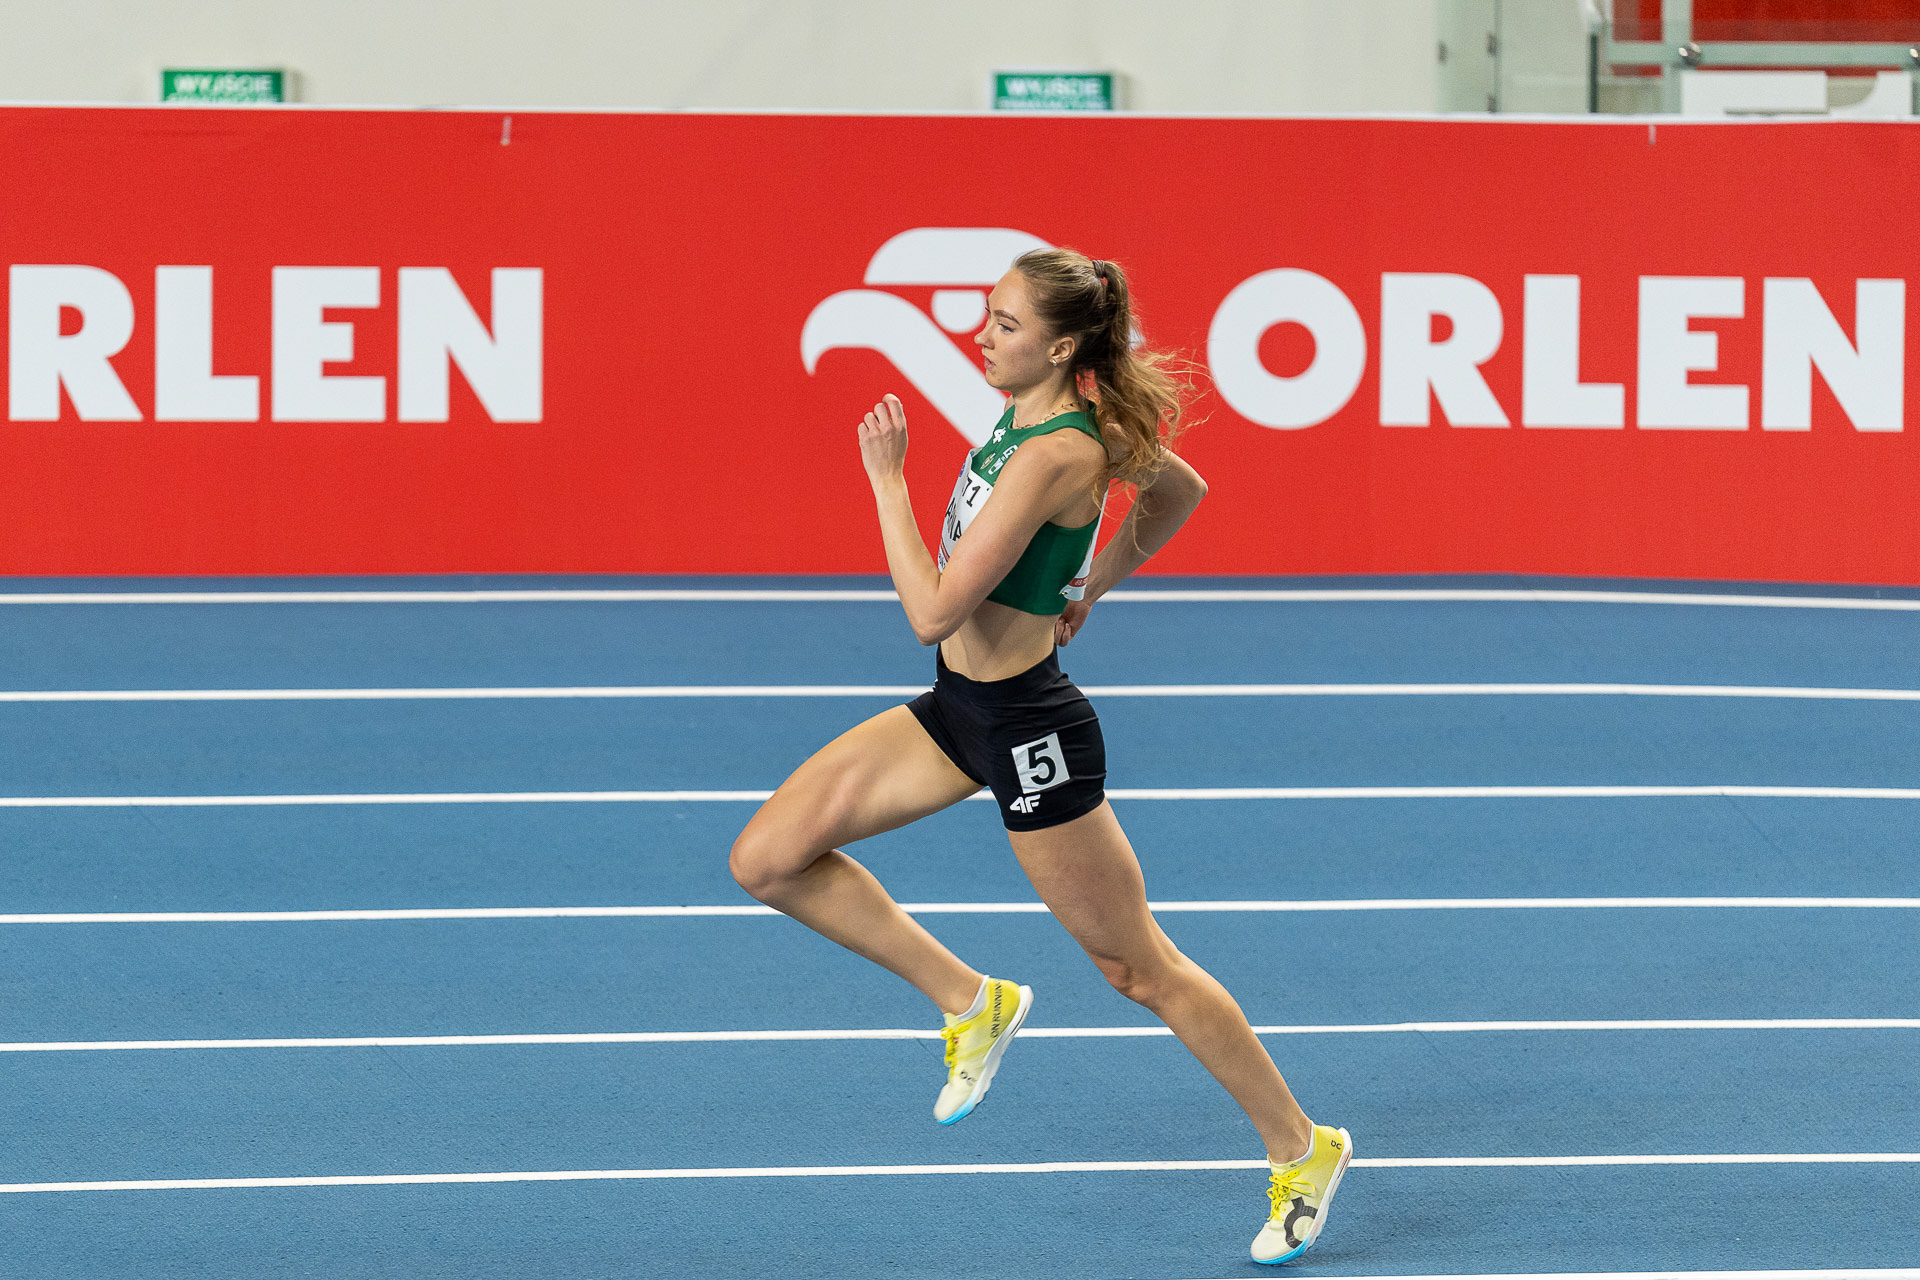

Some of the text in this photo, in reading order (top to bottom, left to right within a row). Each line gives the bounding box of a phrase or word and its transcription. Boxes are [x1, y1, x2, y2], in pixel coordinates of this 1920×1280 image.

[1207, 268, 1905, 432] ORLEN
[1028, 741, 1056, 785] 5
[1009, 794, 1041, 813] 4F
